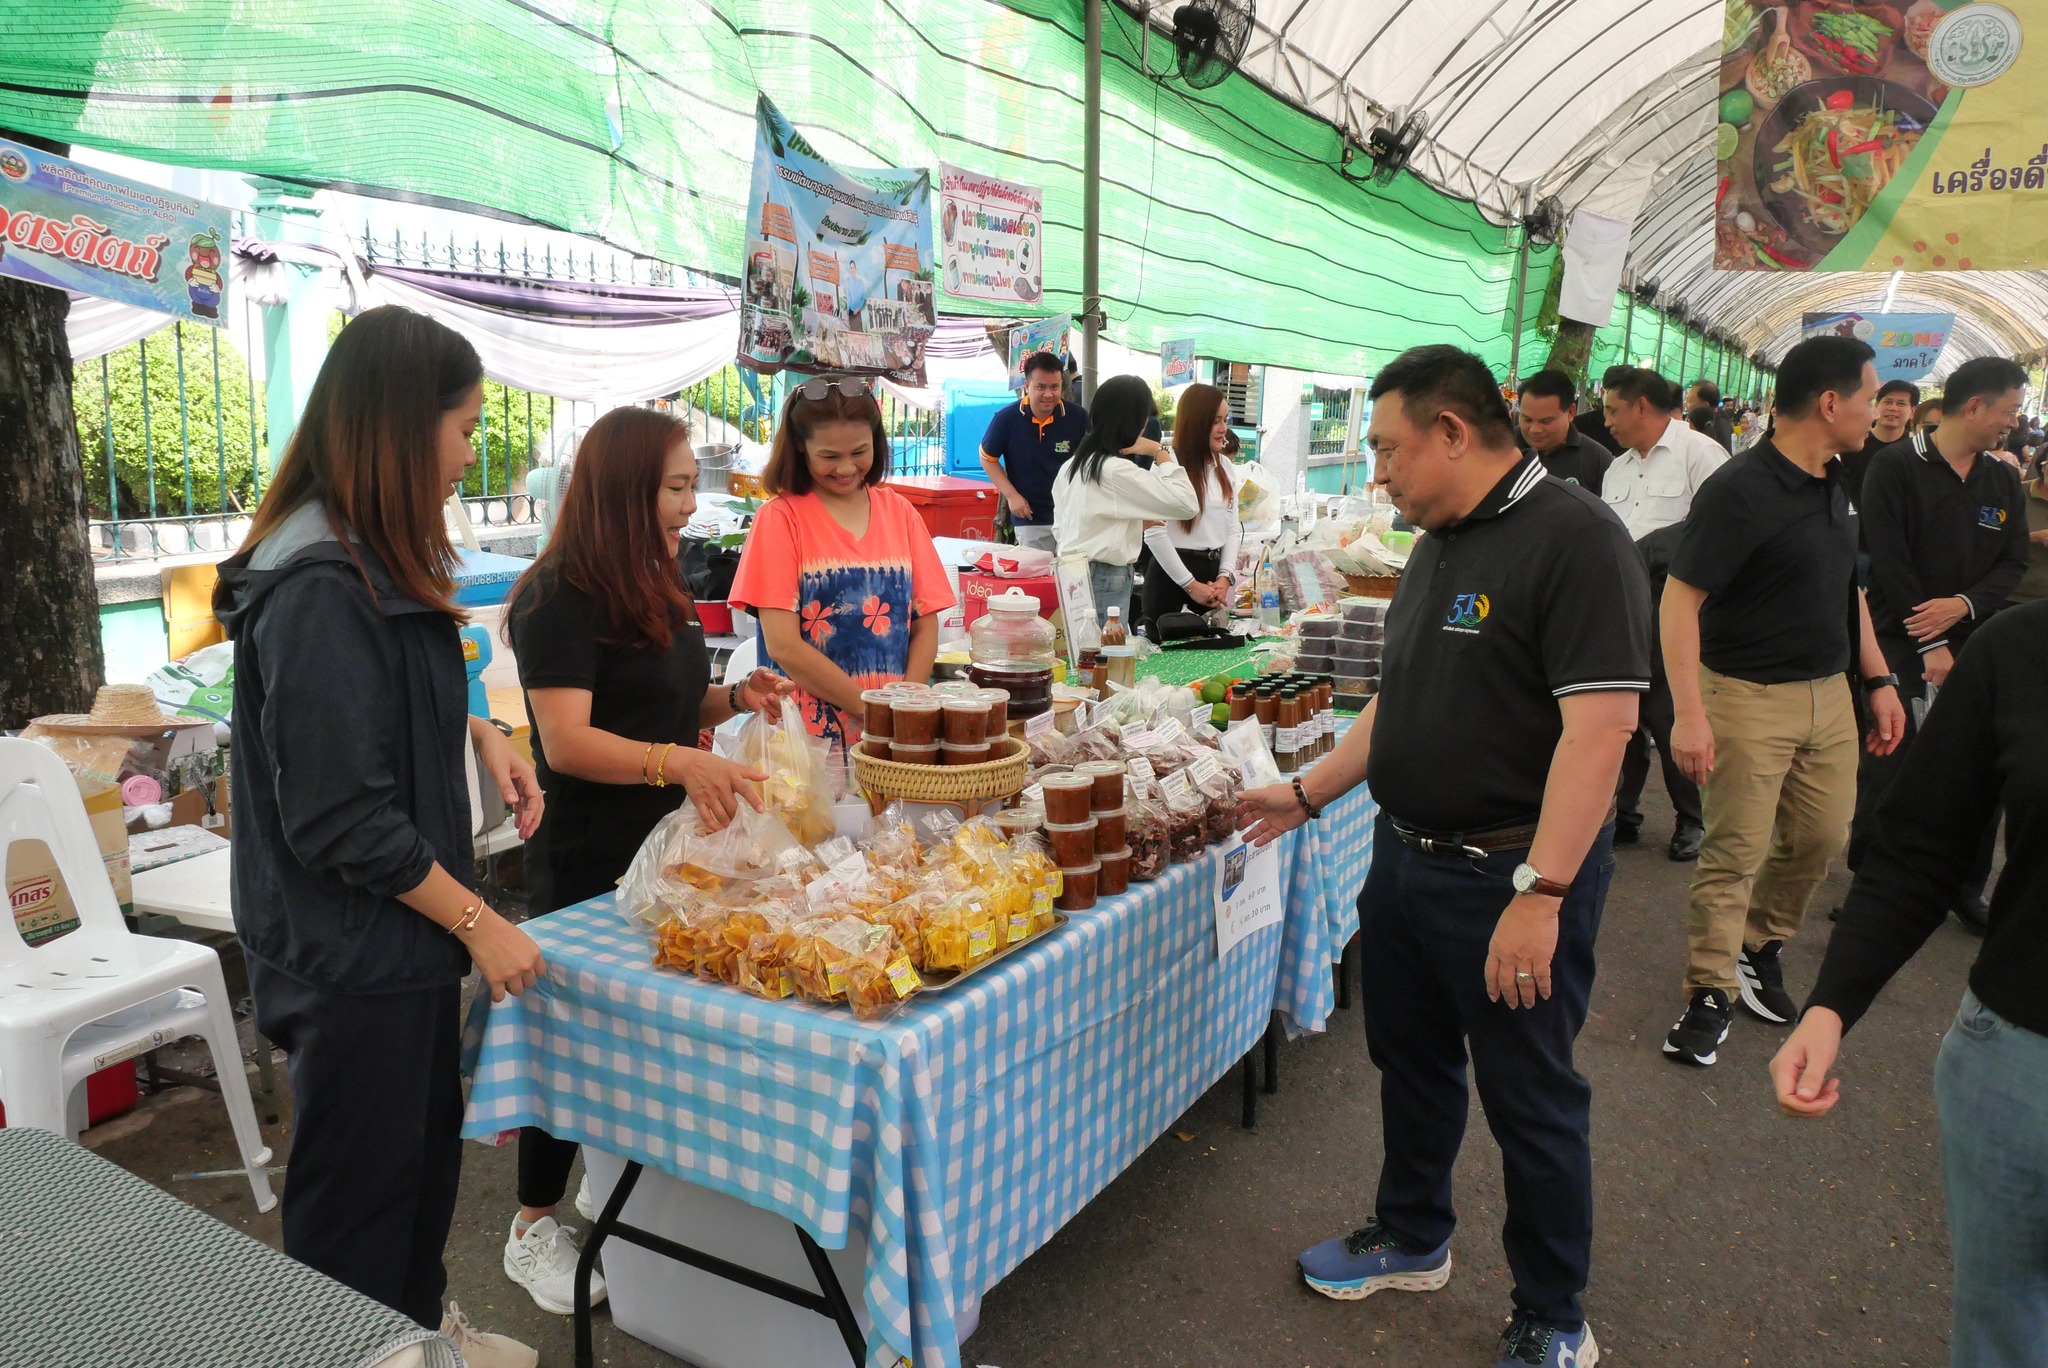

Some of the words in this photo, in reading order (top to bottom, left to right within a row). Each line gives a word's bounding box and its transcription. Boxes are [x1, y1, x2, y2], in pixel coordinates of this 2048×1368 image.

[1932, 143, 2048, 194] เครื่องดื่
[63, 182, 102, 201] (Premium
[103, 194, 140, 212] Products
[142, 207, 151, 215] of
[152, 210, 177, 223] ALRO)
[1880, 331, 1944, 347] ZONE
[1447, 593, 1477, 624] 51
